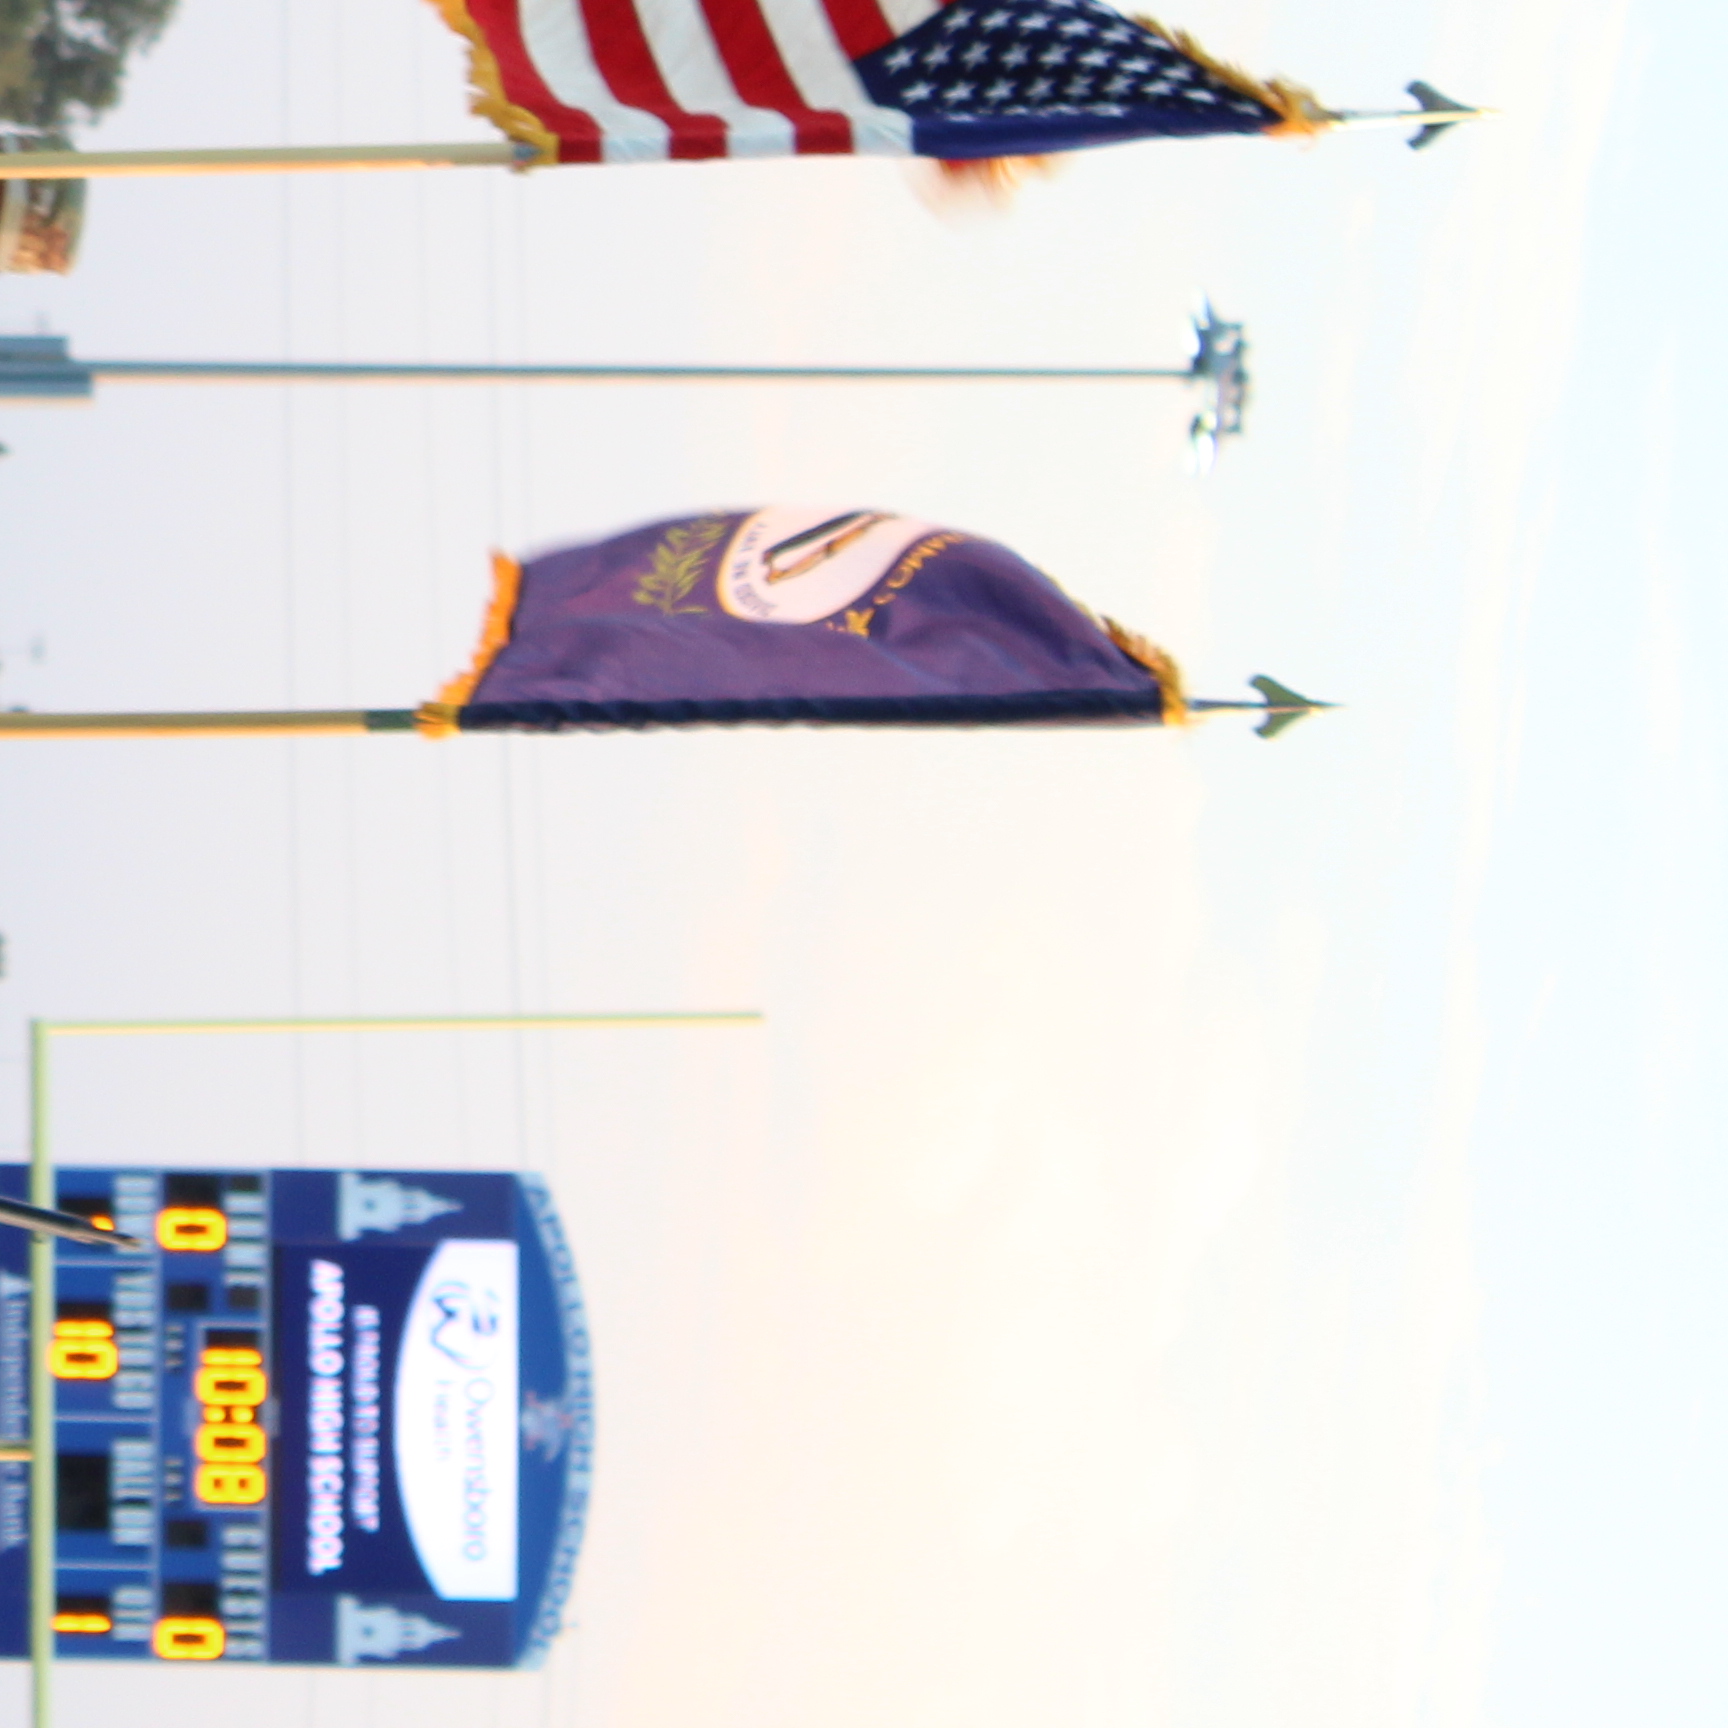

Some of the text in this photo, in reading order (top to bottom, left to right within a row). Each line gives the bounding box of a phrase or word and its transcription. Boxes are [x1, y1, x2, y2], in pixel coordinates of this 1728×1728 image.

[155, 1208, 228, 1252] 0
[223, 1192, 265, 1287] HOME
[47, 1321, 118, 1380] 10
[194, 1348, 268, 1506] 10:08
[308, 1259, 344, 1575] APOLLO HIGH SCHOOL
[433, 1379, 454, 1462] Health
[528, 1186, 595, 1652] APOLLO HIGH SCHOOL
[4, 1483, 29, 1547] Bank
[351, 1436, 380, 1533] SUPPORT
[461, 1377, 496, 1562] Owensboro
[49, 1614, 113, 1634] 1
[152, 1617, 226, 1661] 0
[220, 1525, 265, 1658] GUESTS
